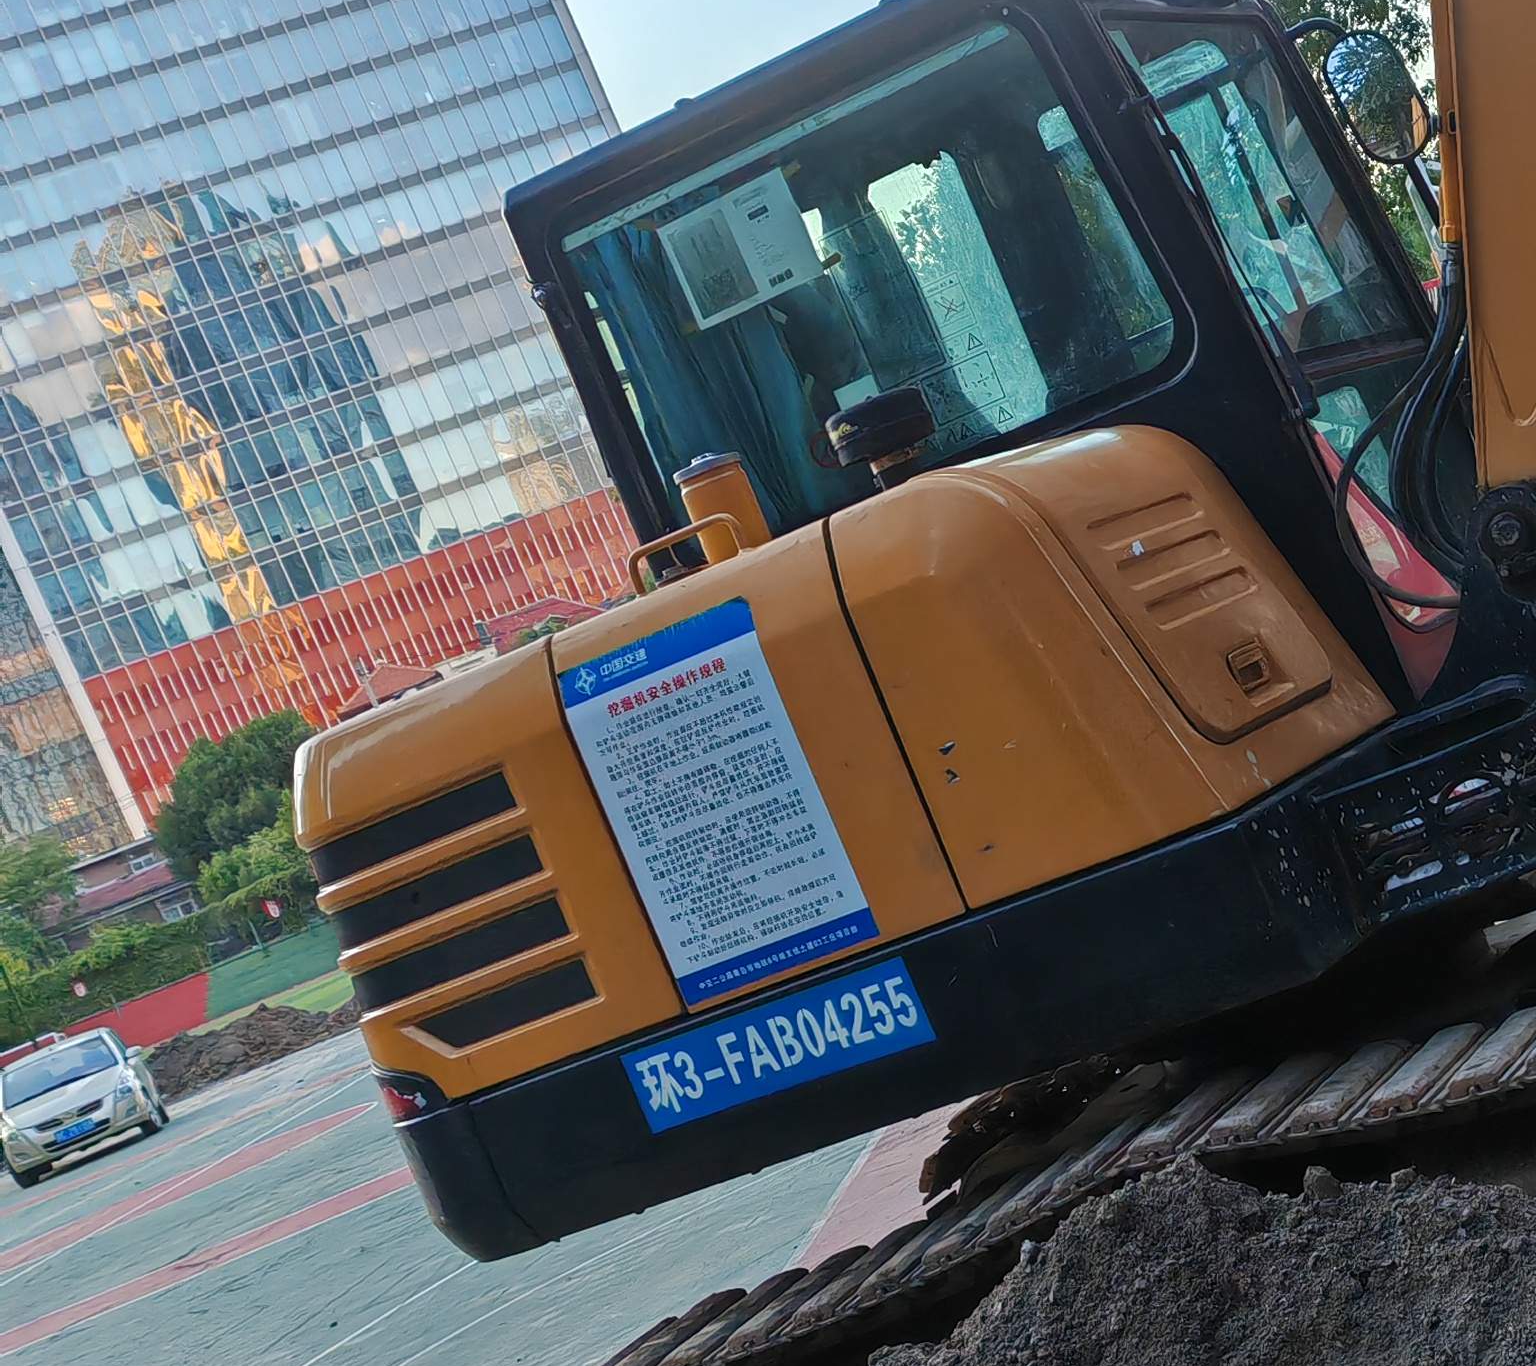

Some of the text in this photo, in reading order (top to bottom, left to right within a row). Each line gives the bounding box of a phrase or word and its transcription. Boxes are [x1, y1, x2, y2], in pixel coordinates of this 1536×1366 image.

[598, 647, 648, 676] 中国交建
[605, 656, 728, 718] 挖掘机安全操作规程
[635, 976, 919, 1113] 环3-FAB04255
